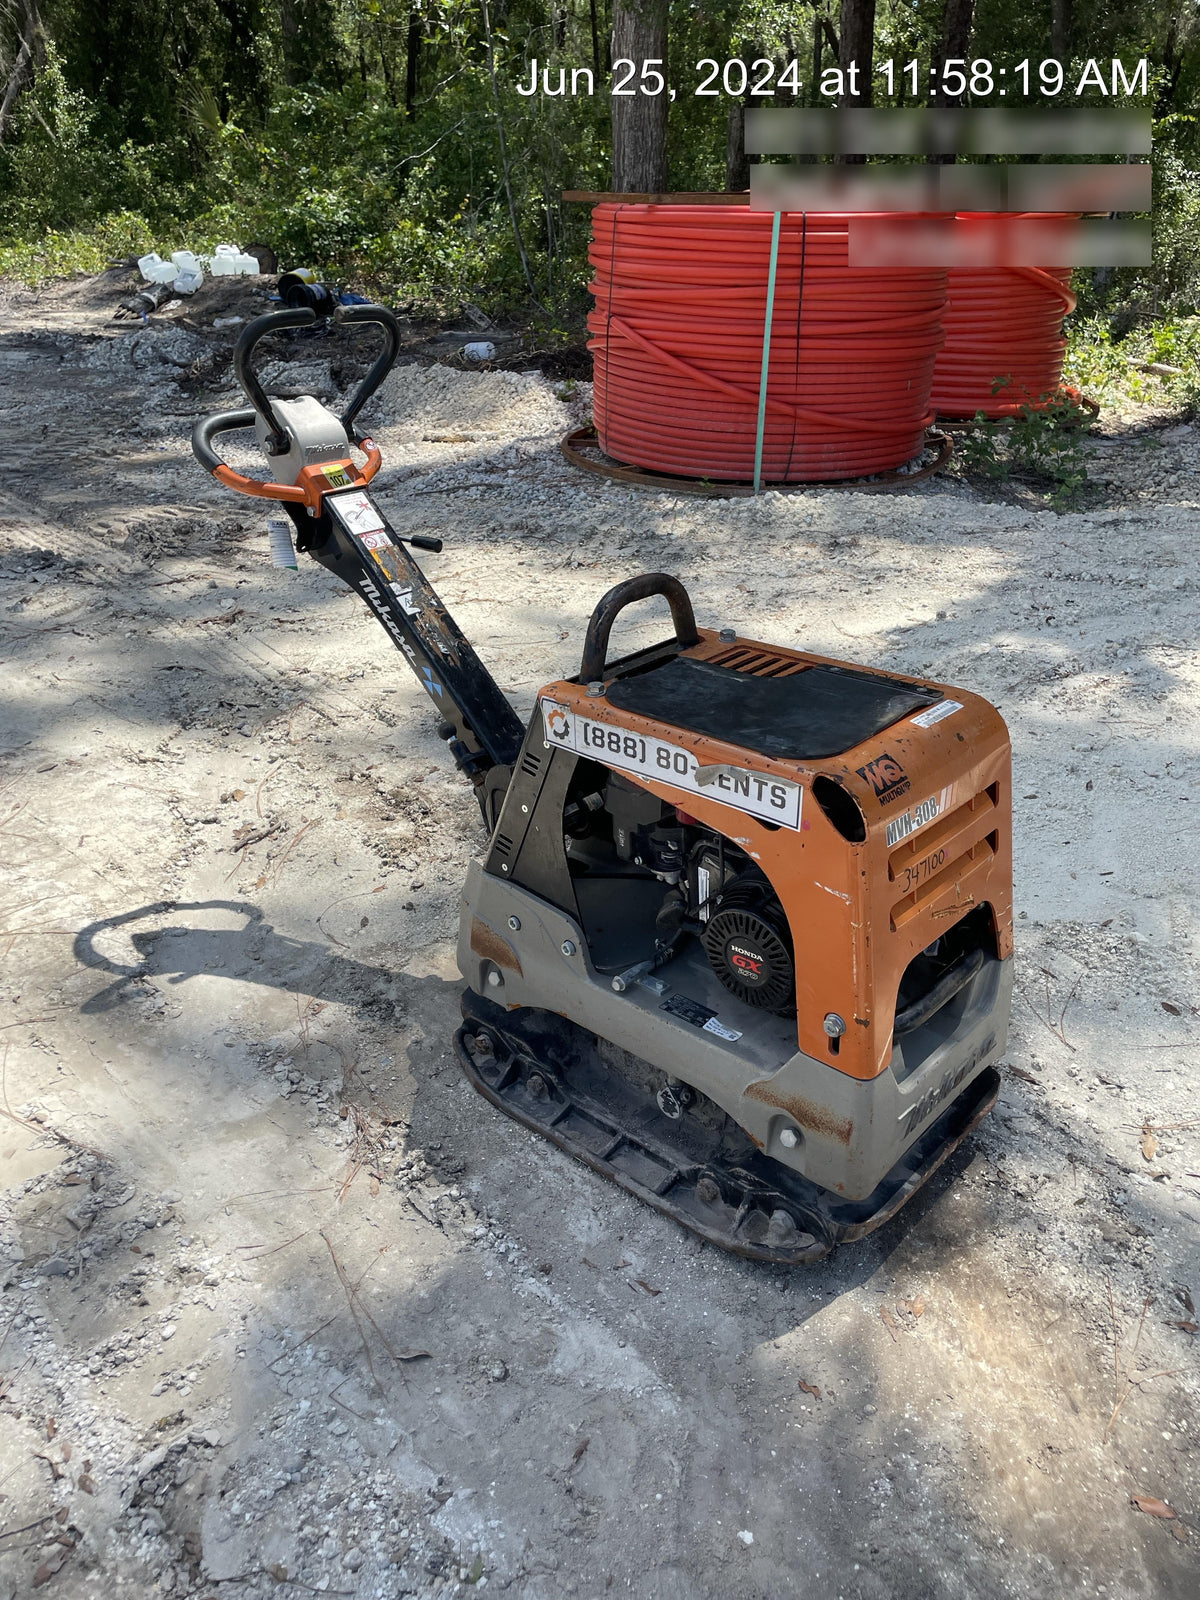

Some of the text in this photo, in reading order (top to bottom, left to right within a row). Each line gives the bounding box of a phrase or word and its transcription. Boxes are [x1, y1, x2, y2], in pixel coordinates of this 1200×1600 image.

[330, 474, 346, 488] 107
[583, 722, 788, 810] (888) 80-ENTS
[886, 796, 939, 848] MVH-308
[902, 849, 945, 893] 347100
[731, 945, 763, 962] HONDA
[732, 955, 762, 974] GX
